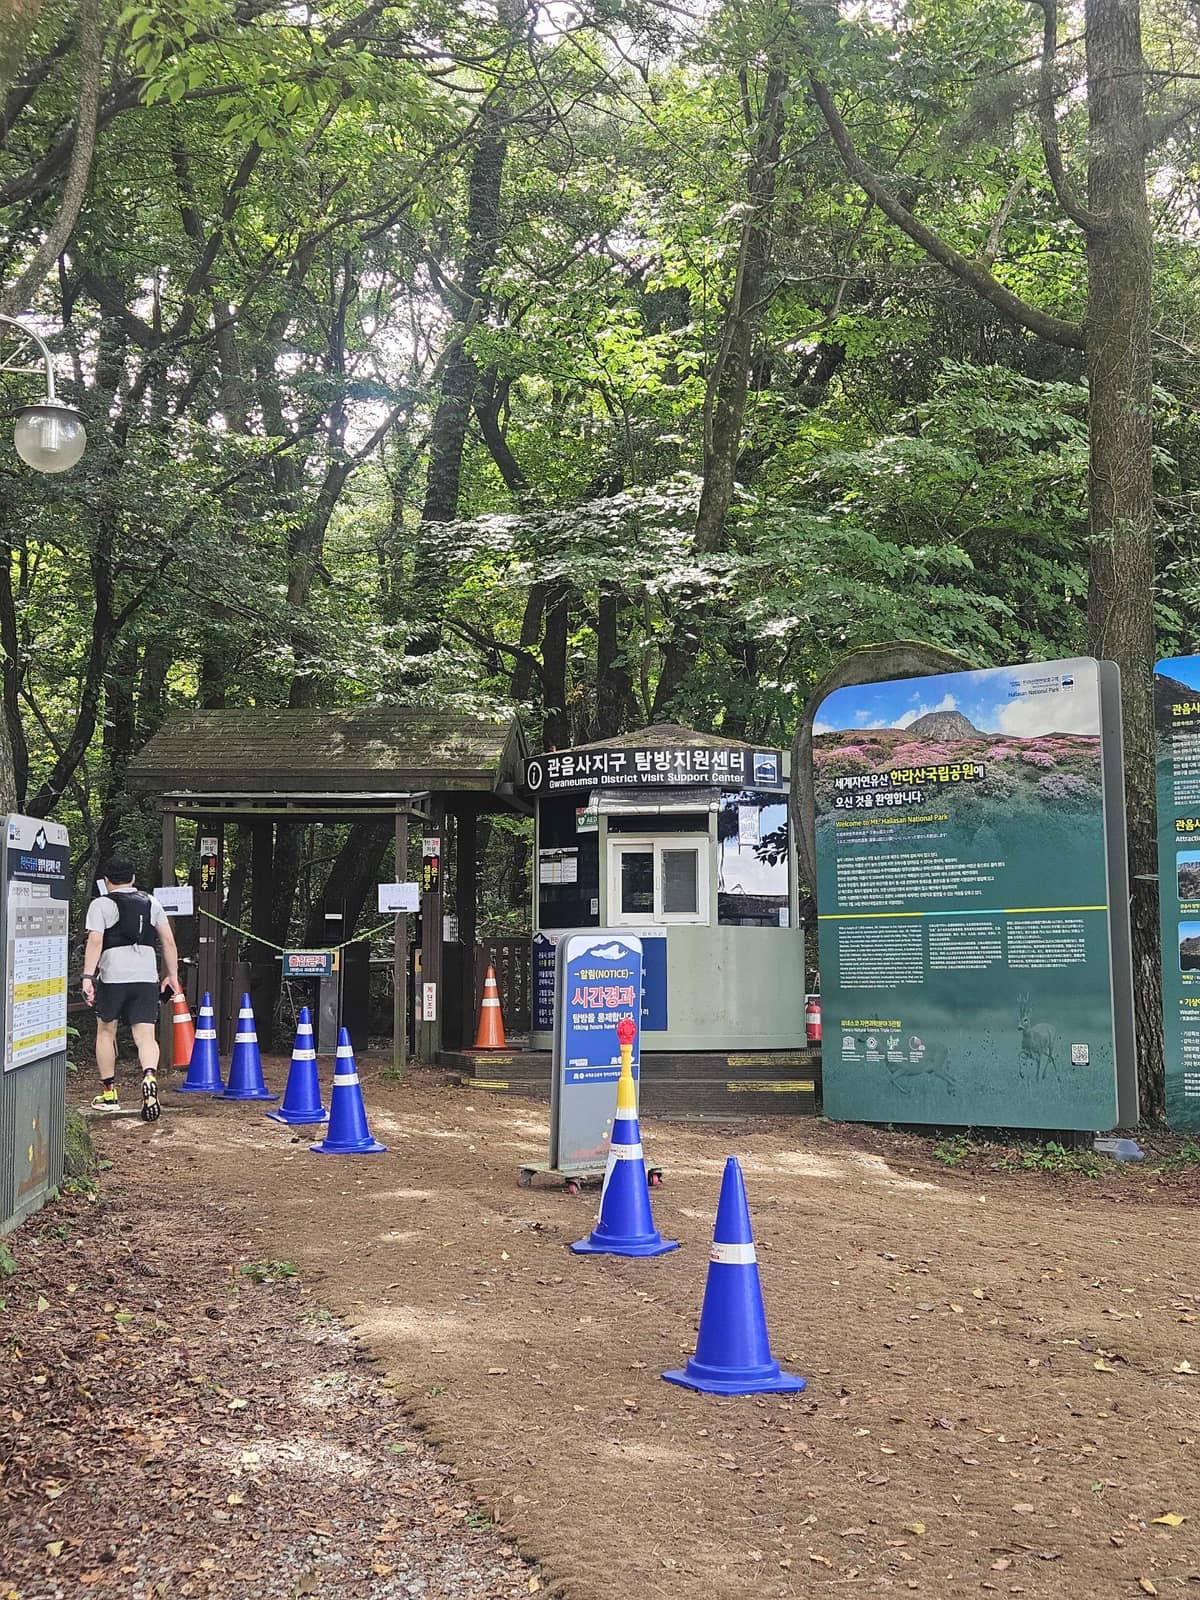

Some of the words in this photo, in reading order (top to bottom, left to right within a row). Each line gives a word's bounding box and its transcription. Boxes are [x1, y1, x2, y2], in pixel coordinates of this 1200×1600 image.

[1029, 688, 1048, 696] National
[547, 753, 627, 778] 관음사지구
[635, 750, 745, 772] 탐방지원센터
[549, 776, 599, 790] Gwaneumsa
[601, 774, 638, 785] District
[641, 773, 665, 783] Visit
[667, 773, 709, 783] Support
[712, 773, 745, 783] Center
[834, 774, 889, 790] 세계자연유산
[890, 764, 984, 786] 한라산국립공원에
[834, 796, 853, 809] 오신
[855, 793, 874, 807] 것을
[875, 790, 926, 806] 환영합니다.
[835, 819, 862, 829] Welcome
[881, 816, 907, 825] Hallasan
[907, 814, 933, 823] National
[934, 813, 949, 821] Park
[571, 985, 636, 1009] 시간경과
[572, 1012, 596, 1024] 탐방을
